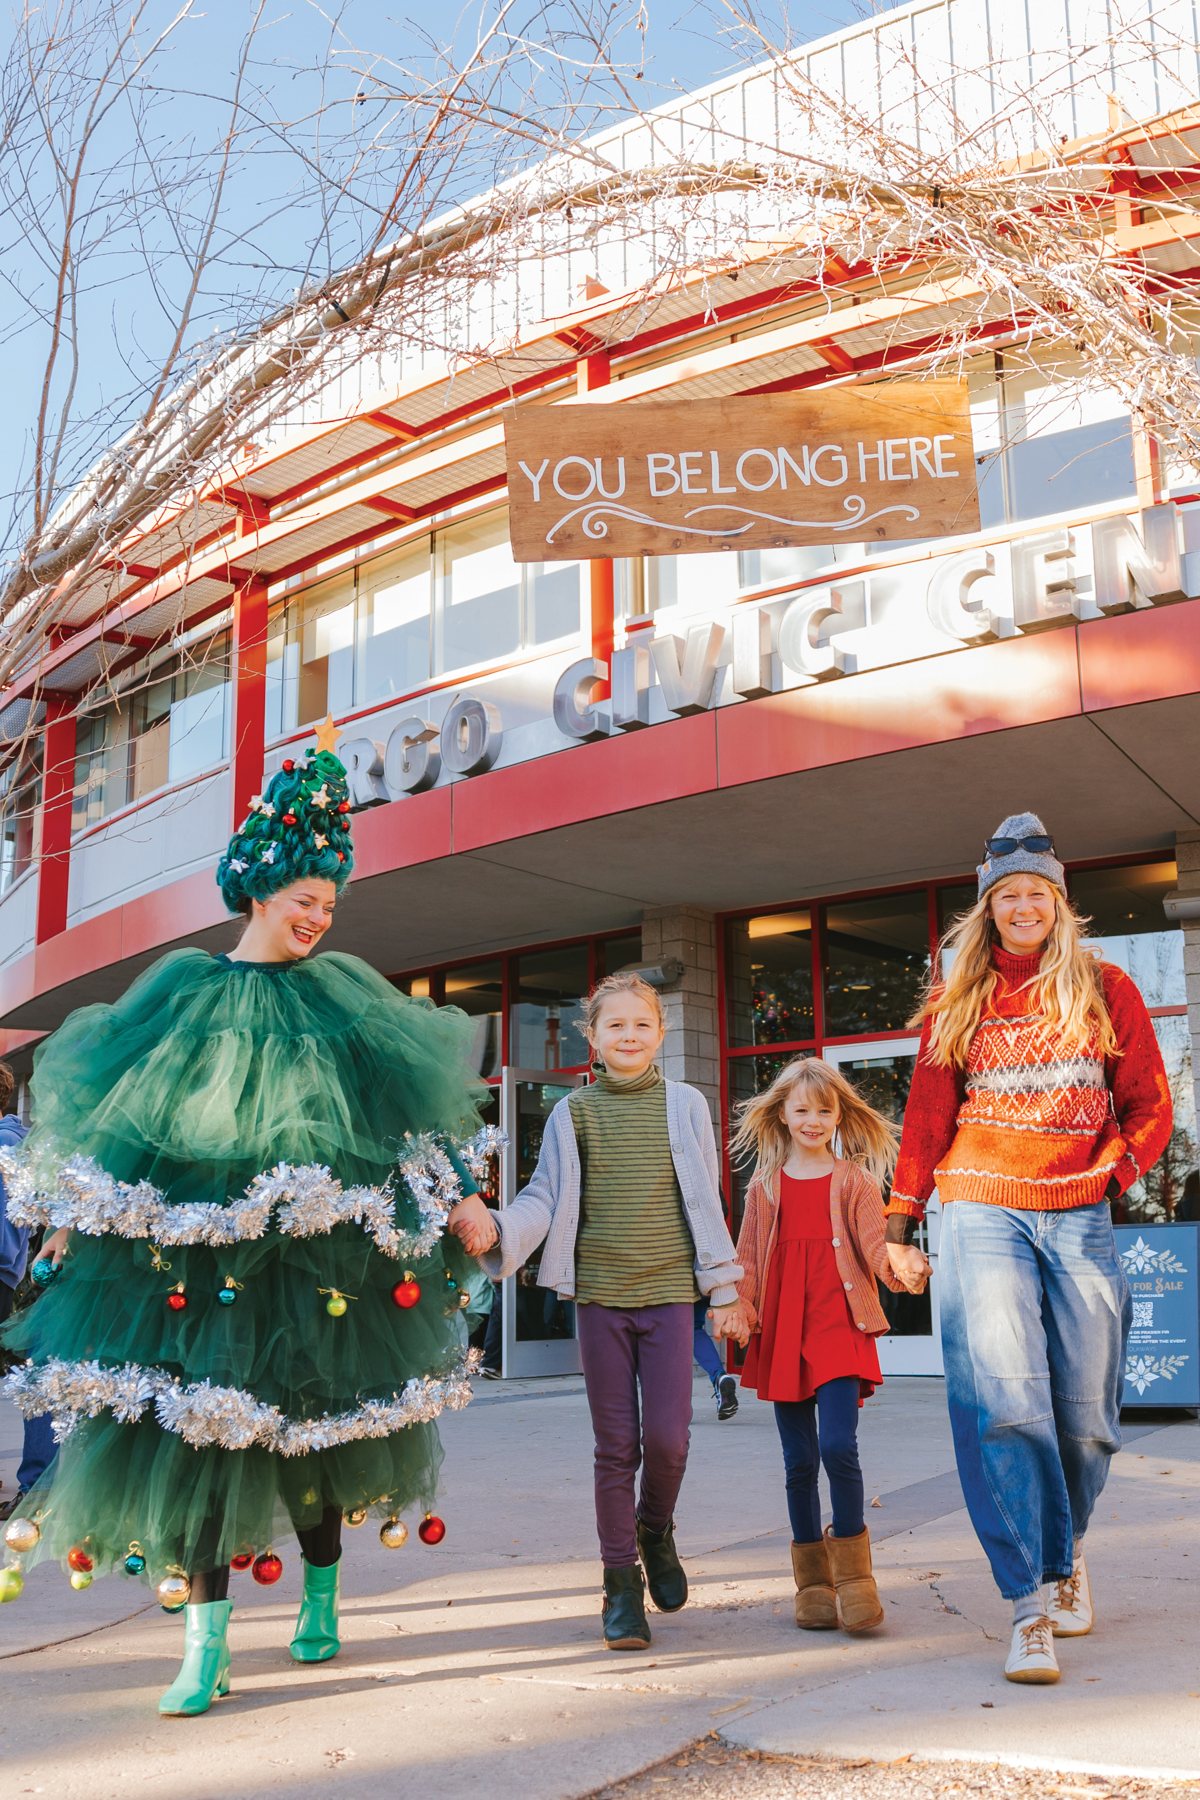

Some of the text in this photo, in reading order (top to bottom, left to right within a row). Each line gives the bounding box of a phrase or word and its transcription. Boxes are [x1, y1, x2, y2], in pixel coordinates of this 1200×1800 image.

[518, 434, 960, 502] YOU BELONG HERE
[553, 586, 844, 742] CIVIC
[927, 501, 1186, 647] CEN
[1133, 1282, 1153, 1291] FOR
